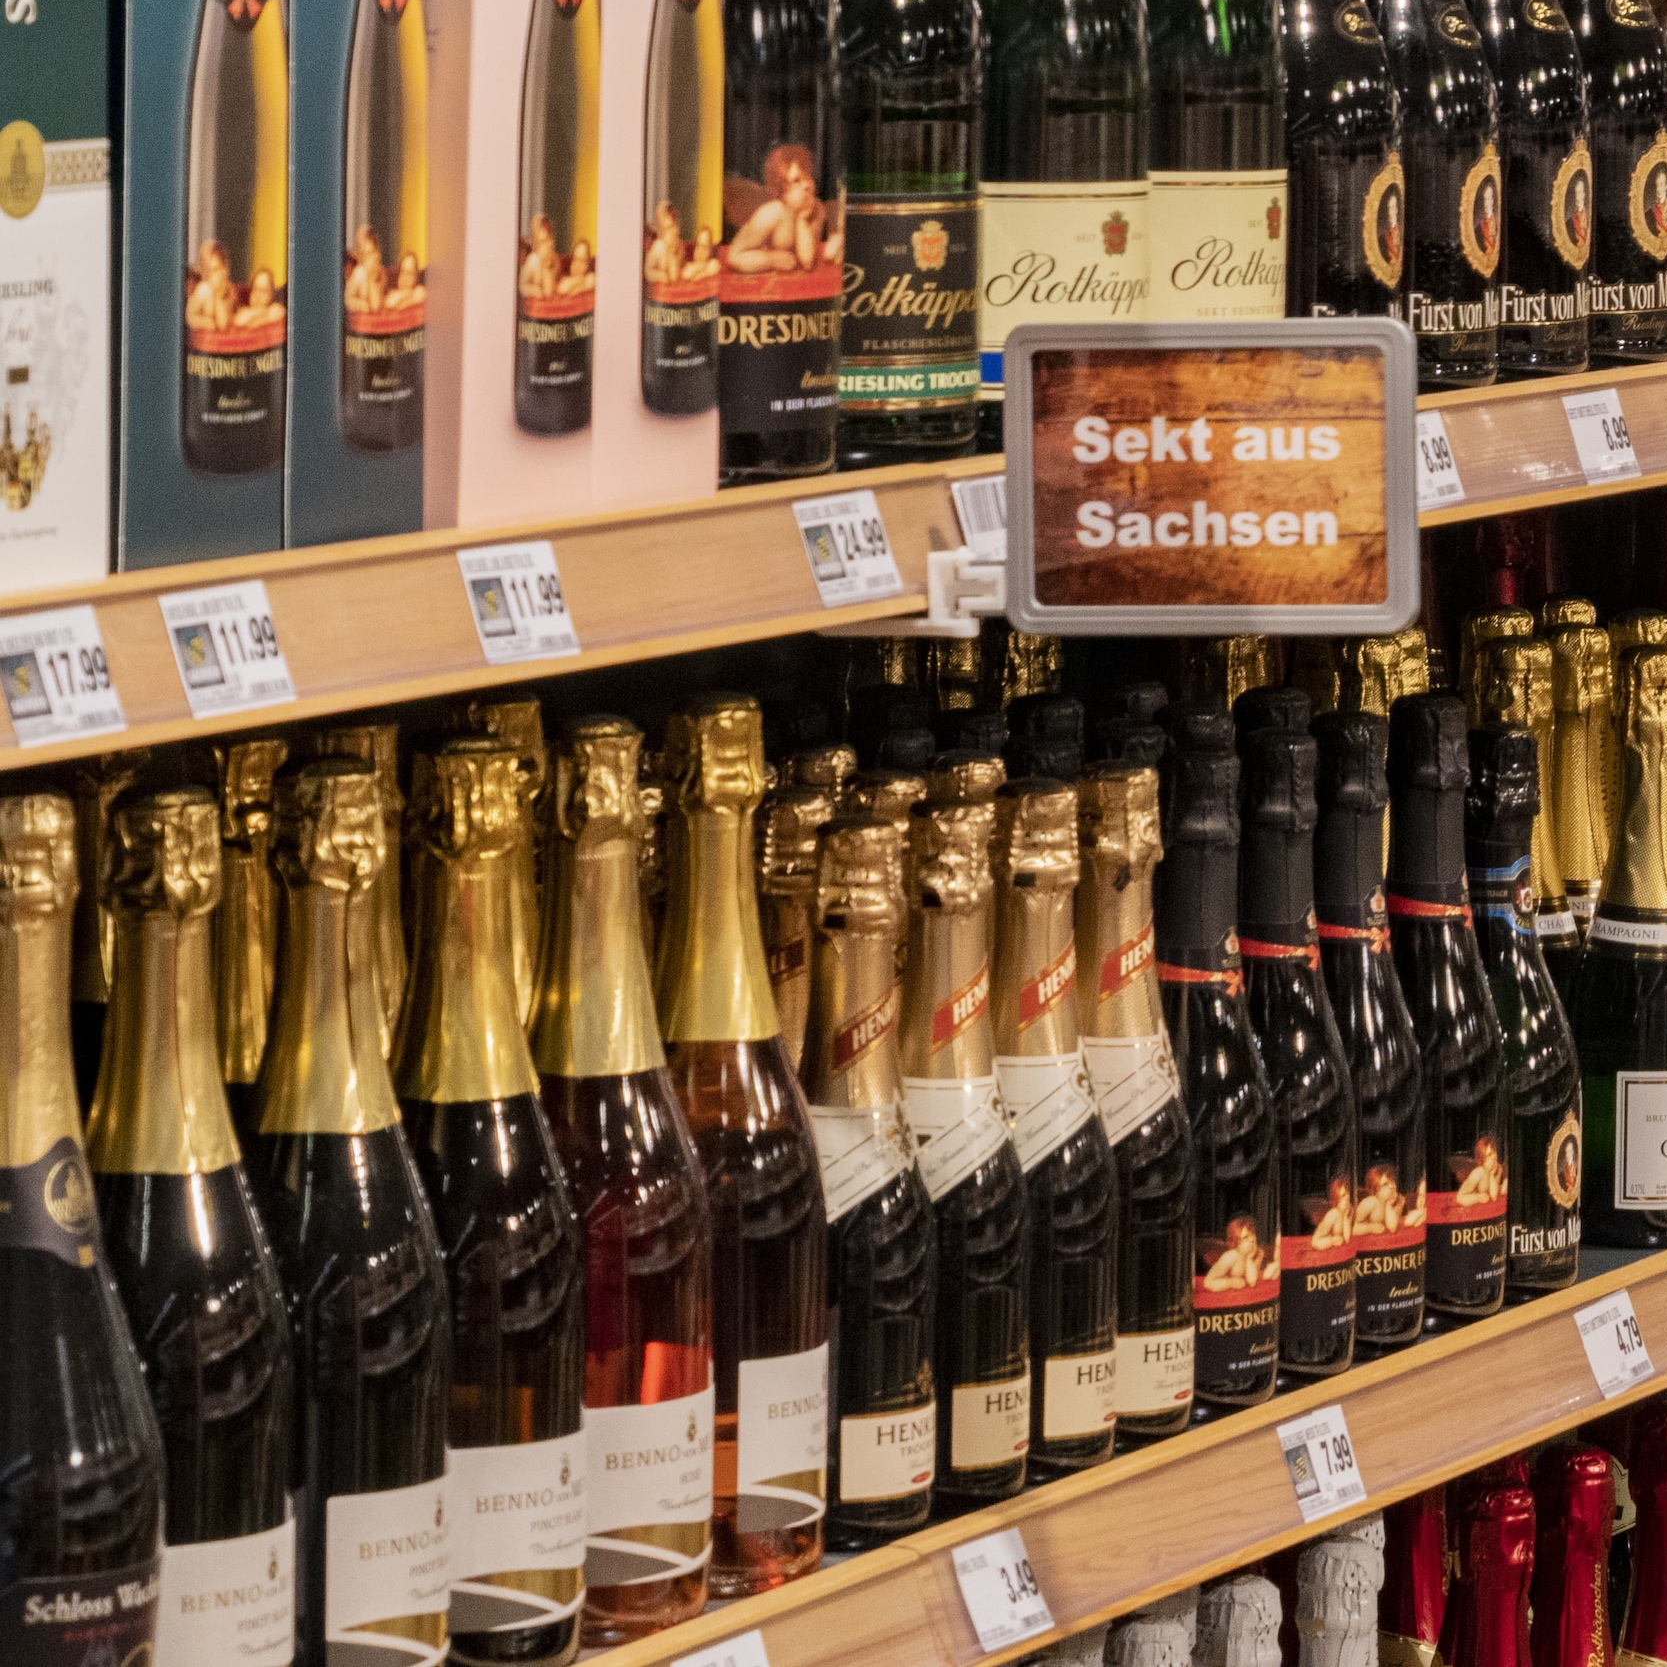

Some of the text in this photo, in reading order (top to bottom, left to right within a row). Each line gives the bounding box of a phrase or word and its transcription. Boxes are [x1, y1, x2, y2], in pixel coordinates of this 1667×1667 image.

[1408, 290, 1483, 334] Fürst von
[1502, 283, 1575, 326] Fürst von
[1627, 280, 1656, 312] von
[838, 374, 925, 396] RIESLING
[1072, 415, 1342, 466] Sekt aus
[1421, 429, 1454, 474] 8.99
[1601, 414, 1632, 452] 8.99
[837, 513, 888, 563] 24.99
[1075, 498, 1340, 549] Sachsen
[511, 572, 569, 621] 11.99
[219, 615, 281, 669] 11.99
[48, 646, 112, 696] 17.99
[1510, 1223, 1565, 1254] Fürst von
[1615, 1314, 1643, 1356] 4.79
[605, 1444, 680, 1472] BENNO
[1318, 1433, 1355, 1478] 7.99
[475, 1487, 553, 1514] BENNO
[358, 1532, 432, 1562] BENNO
[180, 1583, 260, 1614] BENNO
[999, 1557, 1040, 1605] 3.49
[24, 1592, 114, 1626] Schloss
